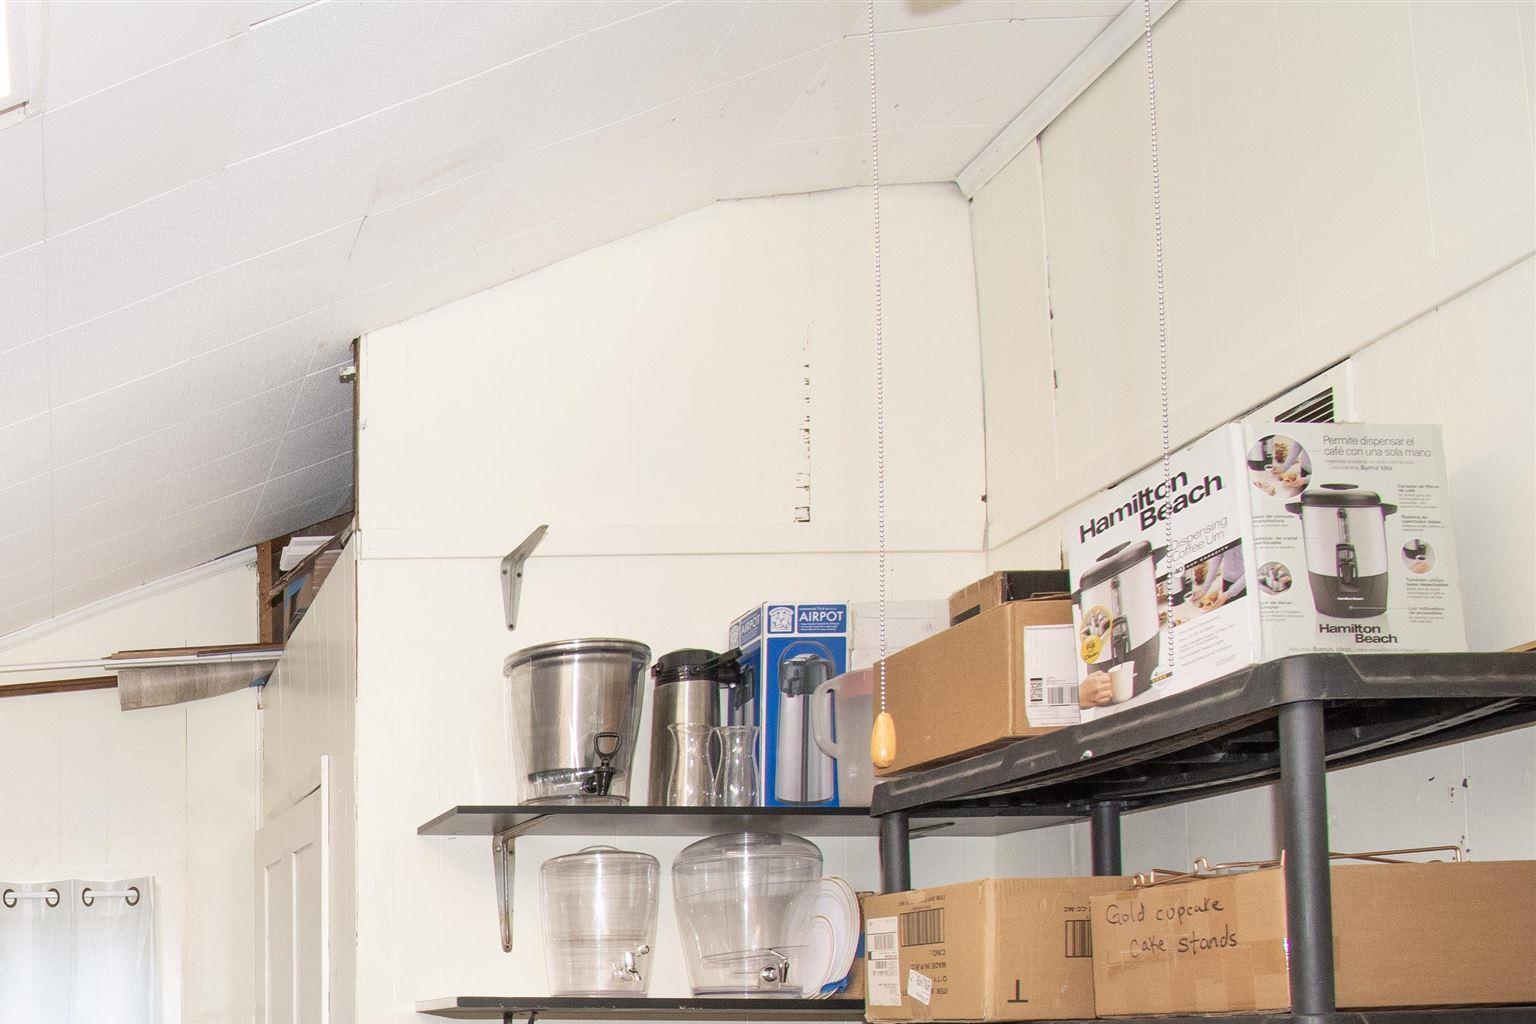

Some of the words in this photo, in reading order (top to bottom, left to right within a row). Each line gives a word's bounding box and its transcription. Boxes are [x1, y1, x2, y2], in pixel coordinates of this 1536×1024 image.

[1323, 435, 1358, 445] Permite
[1360, 436, 1404, 447] dispensar
[1406, 437, 1415, 446] el
[1324, 446, 1344, 456] café
[1346, 448, 1364, 456] con
[1366, 448, 1383, 457] una
[1385, 447, 1404, 457] sola
[1405, 449, 1432, 458] mano
[1080, 471, 1188, 544] Hamilton
[1139, 474, 1223, 532] Beach
[1170, 516, 1228, 549] Dispensing
[1170, 540, 1205, 562] Coffee
[1205, 531, 1225, 547] Urn
[799, 611, 843, 622] AIRPOT
[1319, 623, 1381, 634] Hamilton
[1355, 634, 1398, 644] Beach
[1105, 902, 1145, 926] Gold
[1156, 897, 1224, 925] cupcake
[1177, 923, 1238, 955] stands
